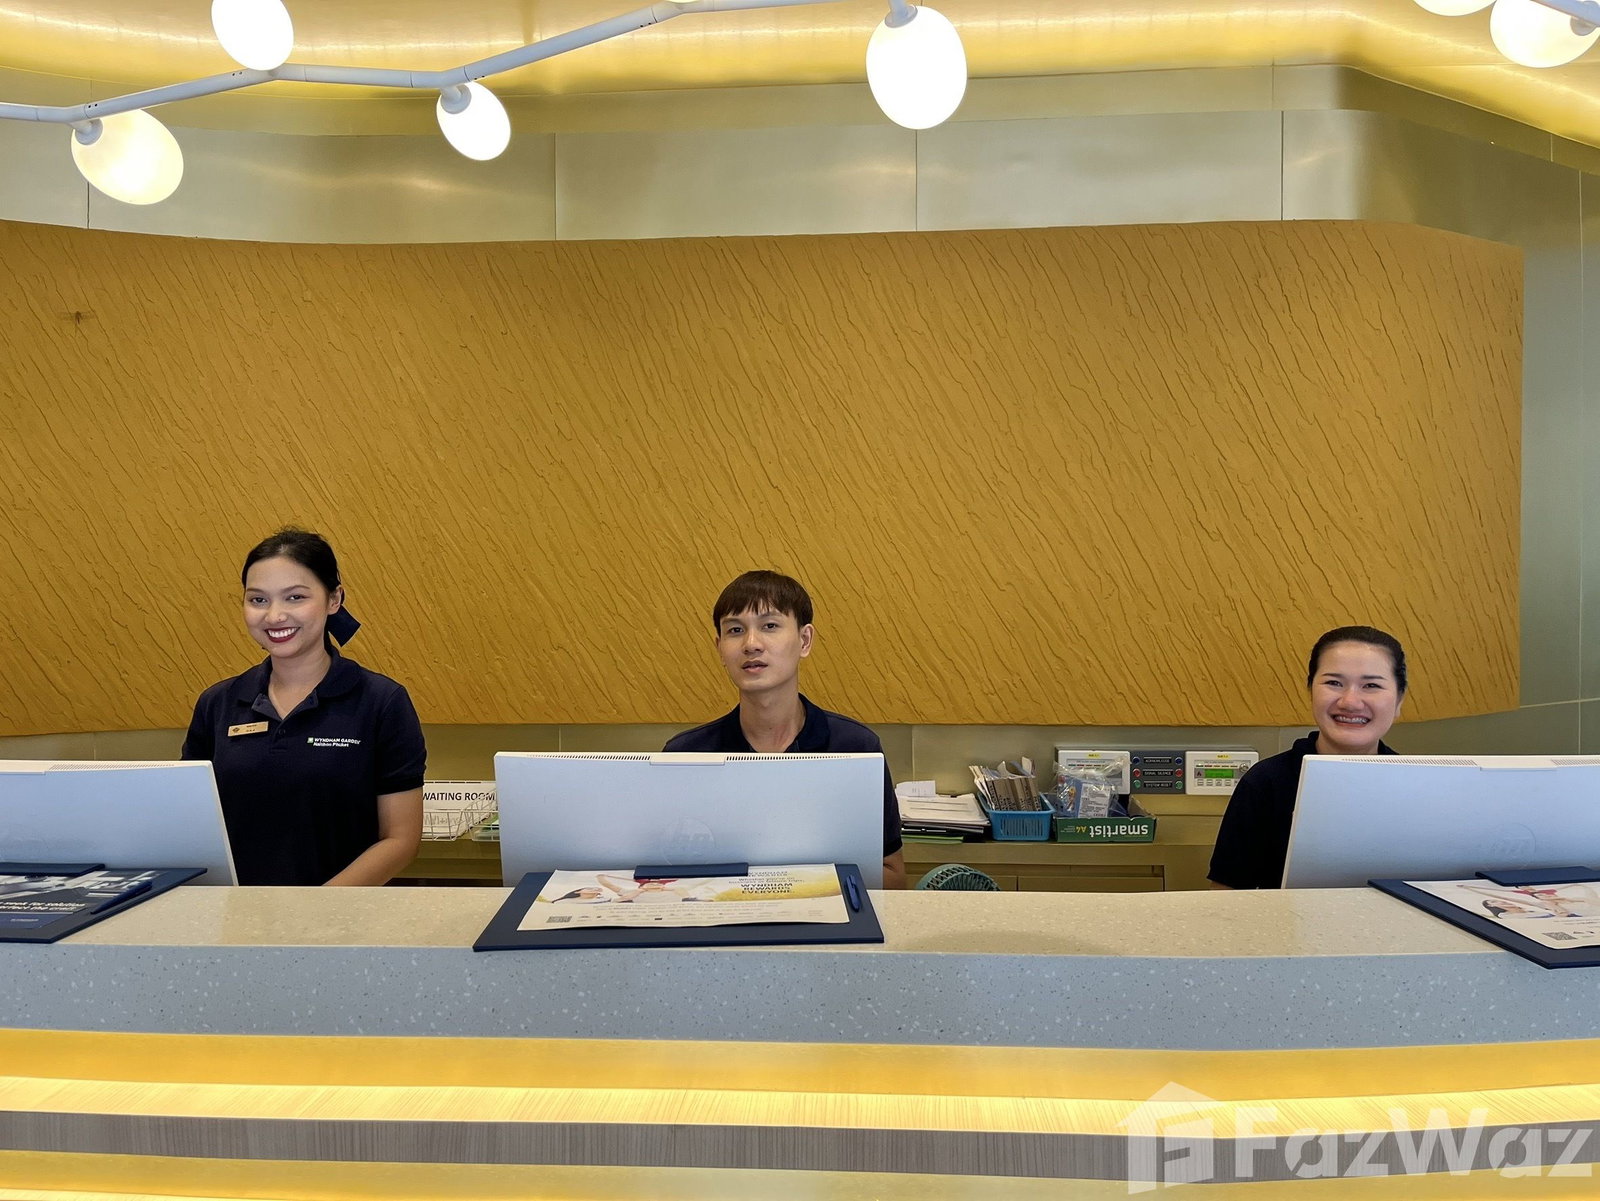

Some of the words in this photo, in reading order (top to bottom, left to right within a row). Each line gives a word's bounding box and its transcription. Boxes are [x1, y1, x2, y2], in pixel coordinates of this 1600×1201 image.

[422, 792, 462, 801] WAITING
[464, 792, 495, 801] ROOM
[1089, 825, 1149, 838] smartist
